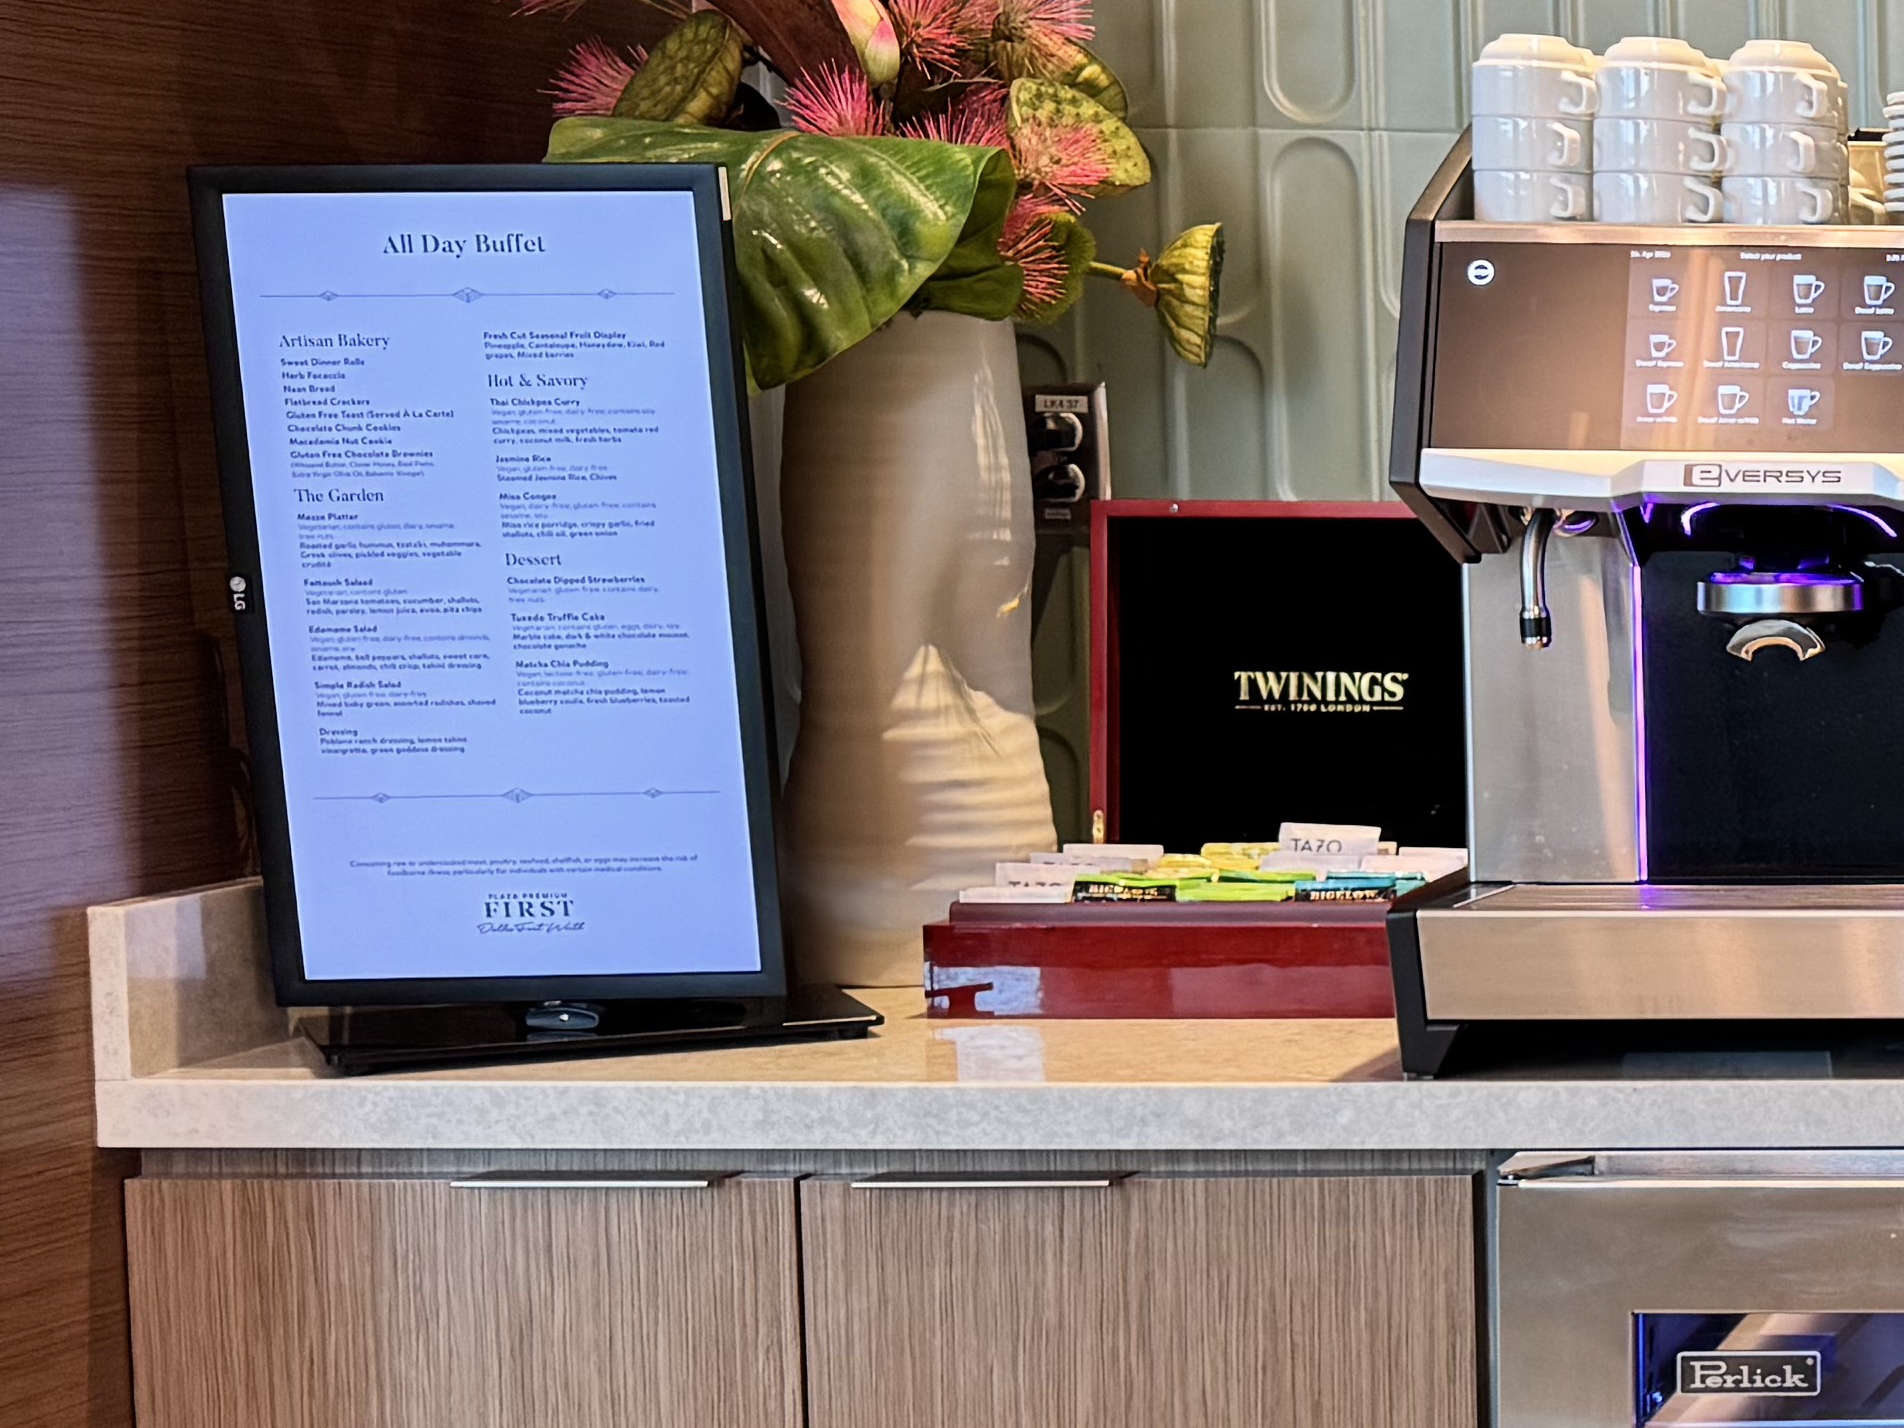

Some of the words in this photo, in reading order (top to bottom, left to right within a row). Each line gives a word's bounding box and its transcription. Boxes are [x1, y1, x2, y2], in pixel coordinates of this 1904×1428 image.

[383, 234, 413, 253] All
[422, 234, 466, 258] Day
[475, 233, 545, 253] Buffet
[280, 335, 333, 347] Artisan
[338, 334, 390, 350] Bakery
[311, 358, 341, 366] Dinner
[488, 375, 513, 387] Hot
[519, 374, 532, 387] &
[537, 374, 588, 390] Savory
[309, 385, 335, 393] Bread
[555, 398, 579, 406] Curry
[294, 489, 323, 502] The
[329, 489, 384, 502] Garden
[506, 553, 562, 566] Dessert
[507, 577, 551, 585] Chocolate
[554, 576, 585, 585] Dipped
[588, 576, 644, 584] Strawberries
[233, 594, 245, 610] LG
[573, 660, 609, 668] Pudding
[1234, 671, 1404, 701] TWININGS
[1320, 704, 1370, 712] LONDON
[319, 728, 357, 736] Dressing
[485, 900, 574, 917] FIRST
[1690, 1360, 1809, 1388] Perlick
